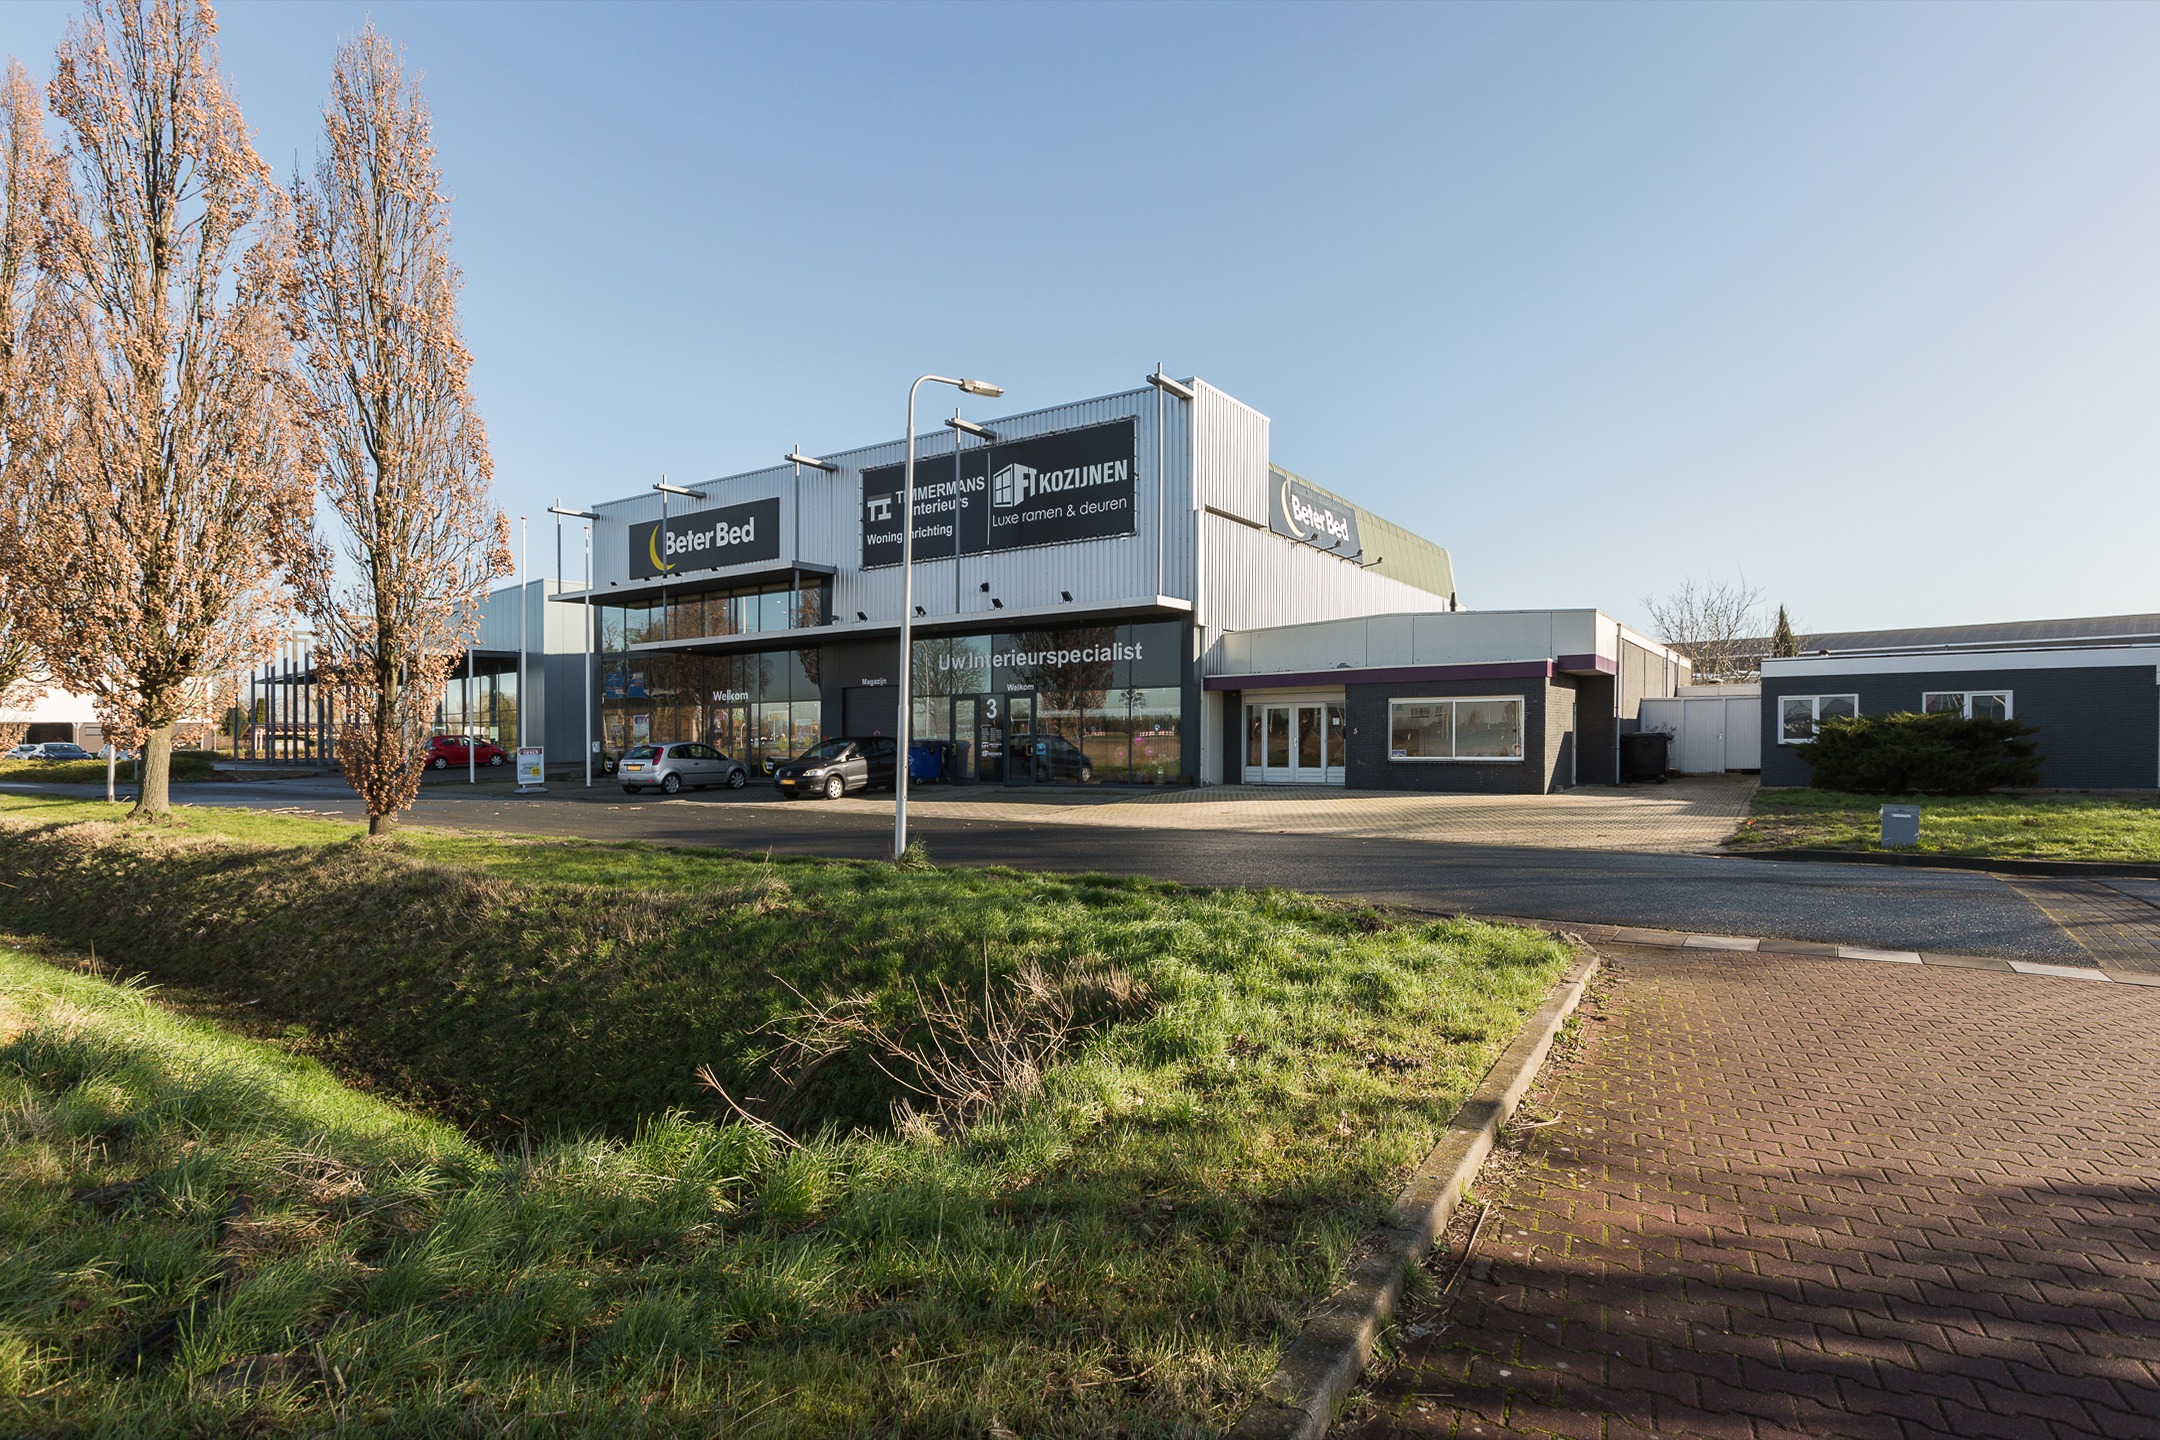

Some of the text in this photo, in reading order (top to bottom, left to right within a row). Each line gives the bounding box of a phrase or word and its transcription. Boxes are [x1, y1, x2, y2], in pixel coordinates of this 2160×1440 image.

[1039, 459, 1128, 494] KOZIJNEN
[895, 476, 985, 504] TMERMANS
[911, 497, 969, 516] nterieus
[992, 497, 1127, 527] Luxe ramen & deuren
[1291, 494, 1350, 542] Beter Bed
[666, 516, 755, 556] Beter Bed
[866, 525, 953, 545] Woningnrichting
[938, 641, 1143, 671] Uw Interieurspecialist
[861, 677, 887, 687] Magazijn
[1006, 683, 1035, 692] Welkom
[712, 689, 749, 702] Welkom
[986, 698, 998, 719] 3
